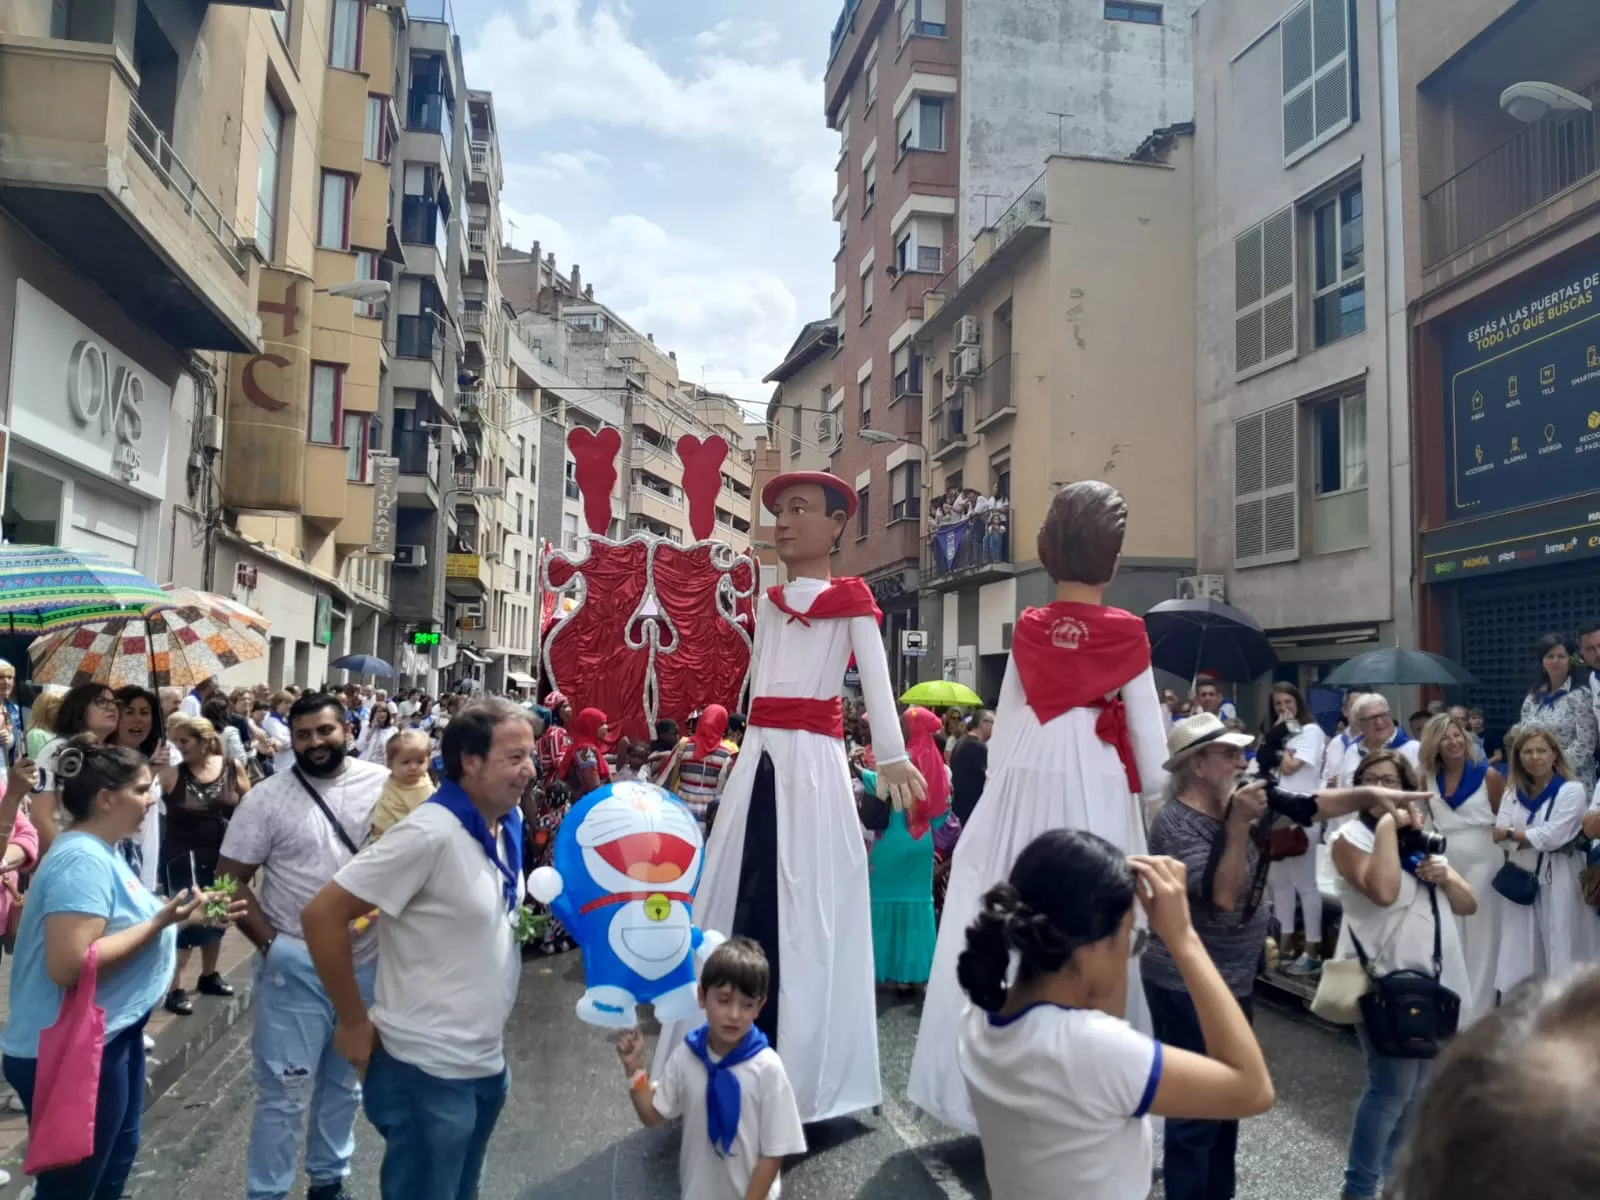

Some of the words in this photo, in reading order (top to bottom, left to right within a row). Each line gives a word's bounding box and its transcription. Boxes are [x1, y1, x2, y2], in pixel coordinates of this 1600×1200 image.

[1468, 321, 1497, 343] ESTÁS
[1499, 318, 1506, 328] A
[1509, 307, 1528, 324] LAS
[1530, 282, 1580, 313] PUERTAS
[1583, 272, 1600, 290] DE
[1477, 331, 1504, 351] TODO
[1506, 323, 1520, 338] LO
[1523, 312, 1545, 331] QUE
[1547, 290, 1593, 320] BUSCAS
[68, 340, 144, 446] OVS
[375, 457, 396, 551] RESTAURANTE
